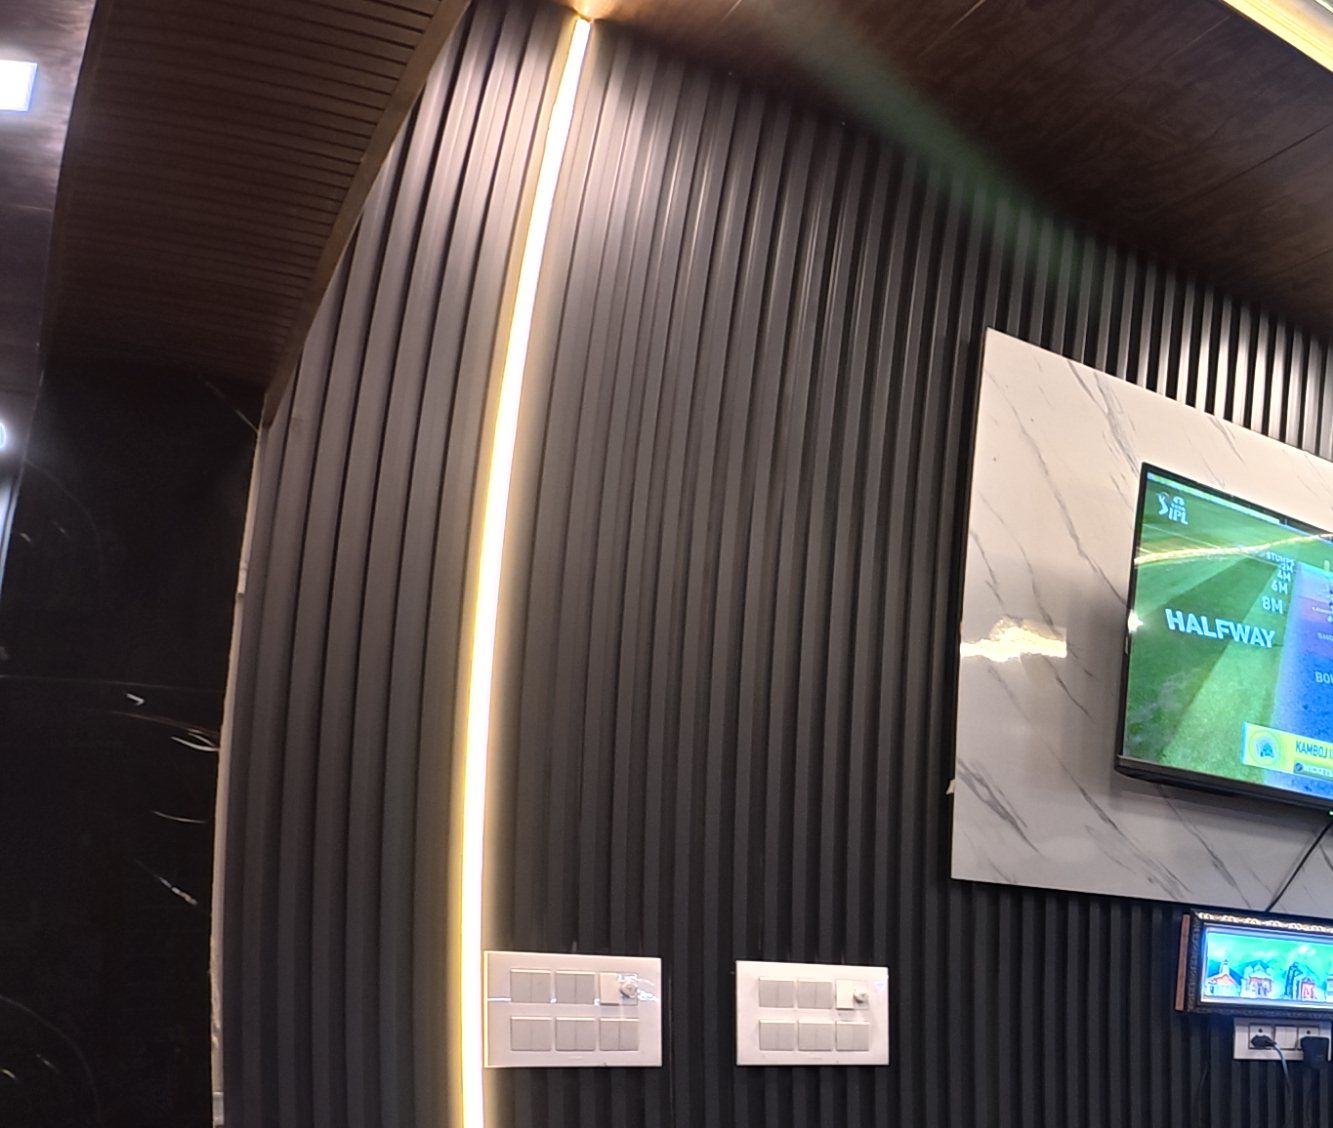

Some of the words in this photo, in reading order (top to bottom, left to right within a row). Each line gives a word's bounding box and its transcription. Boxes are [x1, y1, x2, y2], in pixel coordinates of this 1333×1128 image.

[1168, 507, 1188, 524] IPL
[1271, 579, 1288, 595] 6M
[1261, 596, 1283, 614] 8M
[1165, 608, 1275, 648] HALFWAY
[1296, 740, 1328, 758] KAMBOJ
